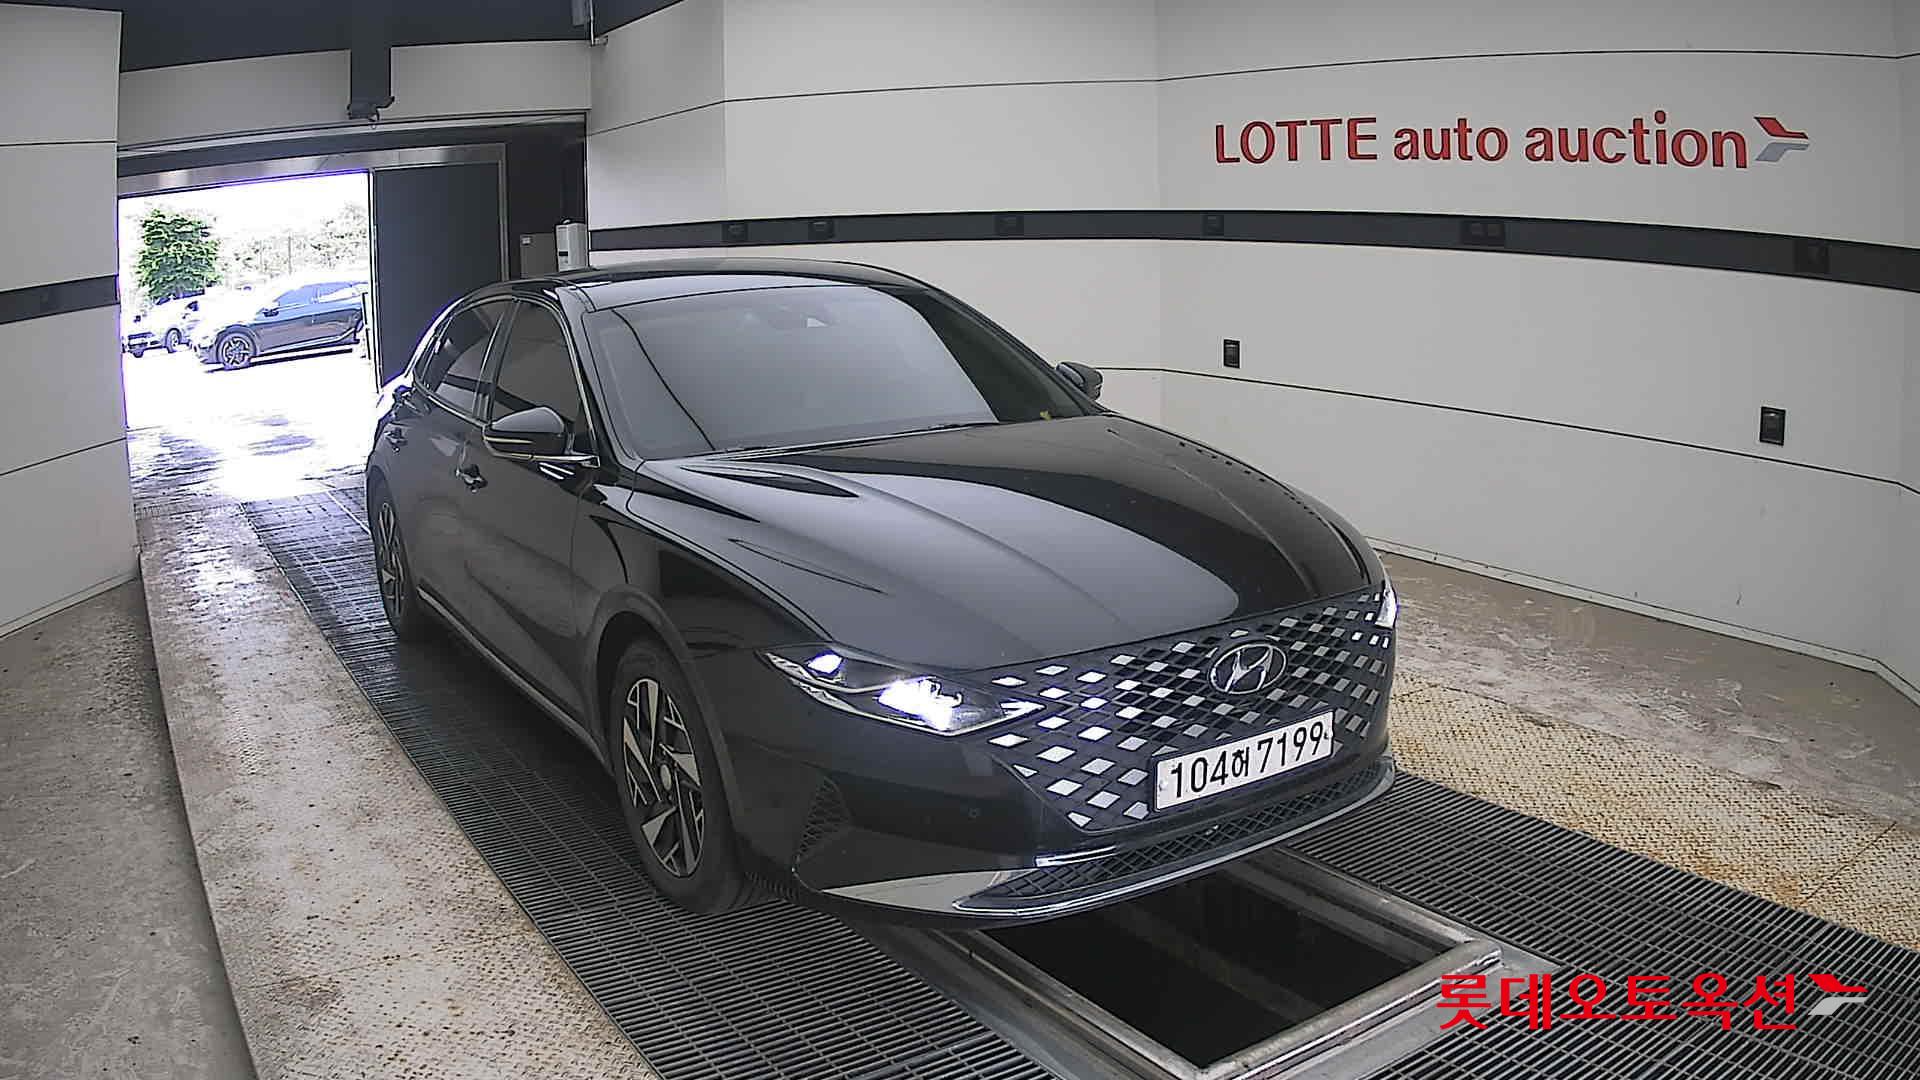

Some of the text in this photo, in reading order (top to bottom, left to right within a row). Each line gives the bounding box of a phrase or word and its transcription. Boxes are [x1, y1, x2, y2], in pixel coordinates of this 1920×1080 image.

[1214, 110, 1748, 169] LOTTE auto auction
